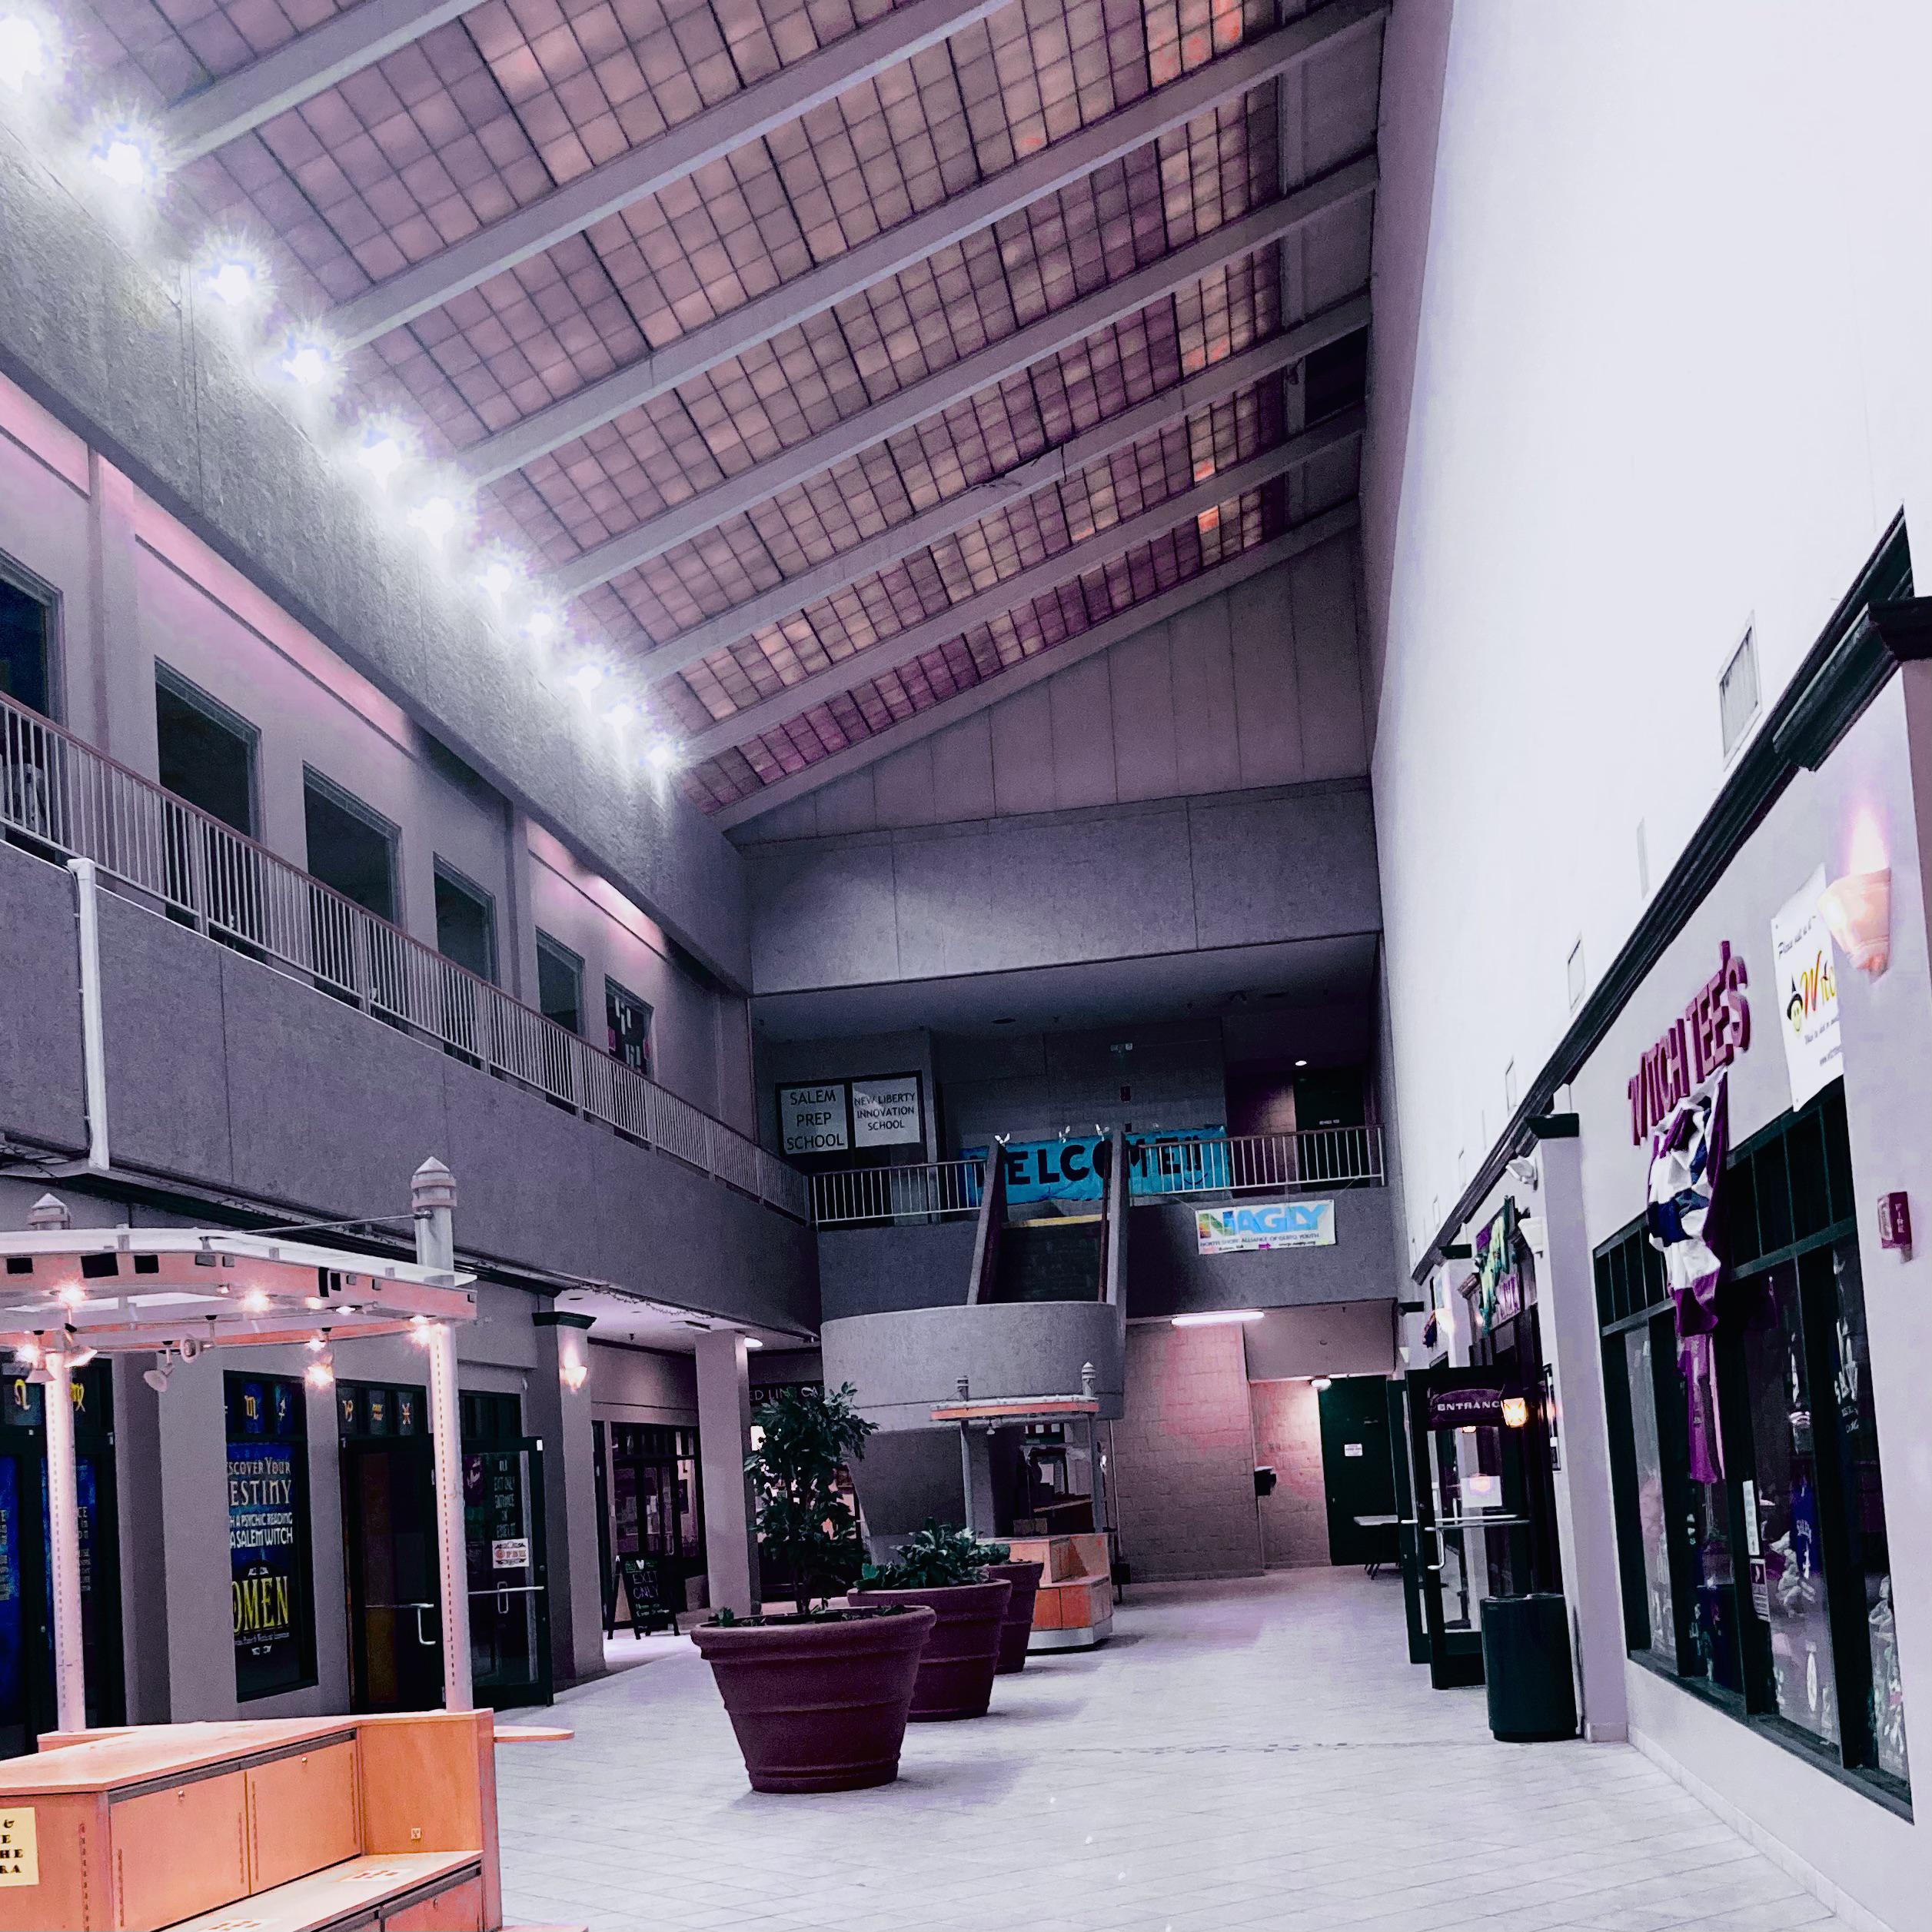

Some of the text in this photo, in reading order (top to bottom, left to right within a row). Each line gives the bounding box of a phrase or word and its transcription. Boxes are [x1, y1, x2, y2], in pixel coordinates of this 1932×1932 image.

[790, 1089, 836, 1106] SALEM
[854, 1092, 916, 1106] NEW LIBERTY
[796, 1112, 832, 1127] PREP
[856, 1106, 915, 1119] INNOVATION
[867, 1119, 905, 1131] SCHOOL
[786, 1132, 845, 1151] SCHOOL
[1198, 1203, 1331, 1239] NAGLY
[1437, 1400, 1501, 1412] ENTRANC
[228, 1460, 264, 1475] SCOVER
[229, 1479, 291, 1506] ESTINY
[236, 1528, 264, 1548] SALEM
[264, 1526, 294, 1546] WITCH
[231, 1575, 289, 1634] OMEN
[0, 1848, 24, 1859] HE
[0, 1864, 23, 1874] RA
